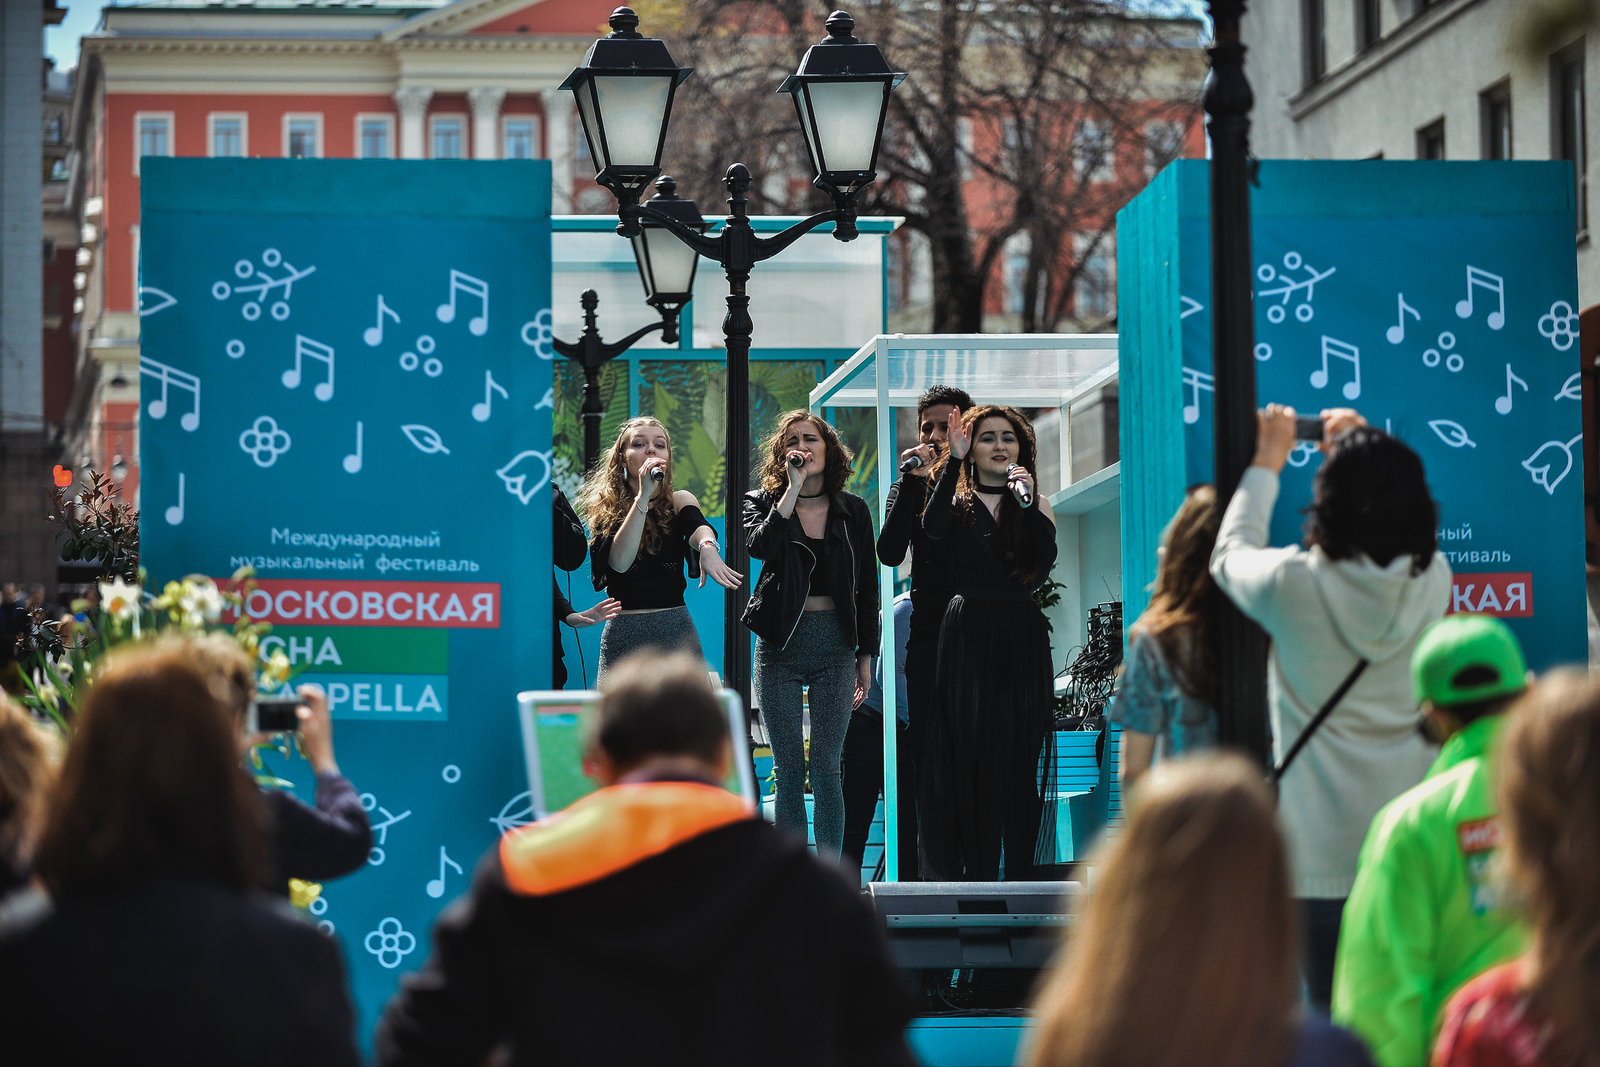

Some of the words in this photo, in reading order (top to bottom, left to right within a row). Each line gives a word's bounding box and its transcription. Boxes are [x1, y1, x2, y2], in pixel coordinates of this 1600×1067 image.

[270, 526, 441, 549] Международный
[229, 553, 365, 570] музыкальный
[375, 552, 480, 574] фестиваль
[1445, 549, 1511, 563] тиваль
[257, 635, 343, 665] СНА
